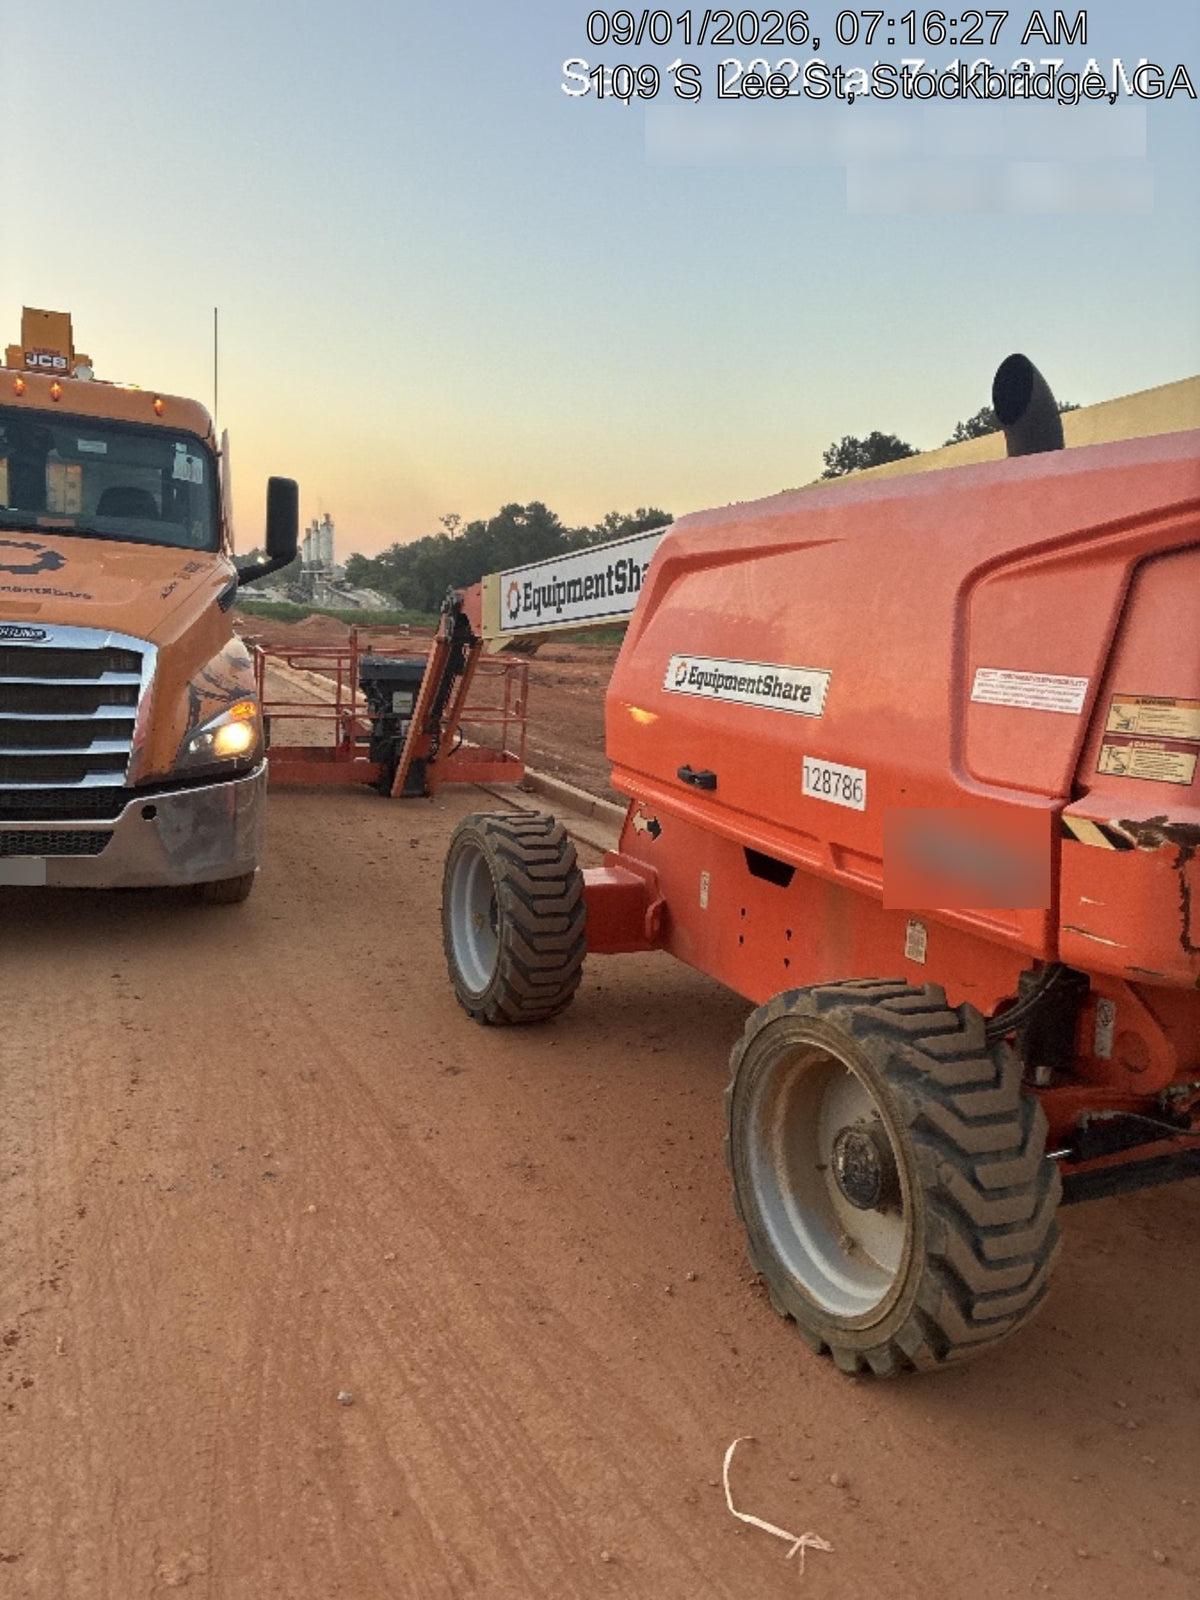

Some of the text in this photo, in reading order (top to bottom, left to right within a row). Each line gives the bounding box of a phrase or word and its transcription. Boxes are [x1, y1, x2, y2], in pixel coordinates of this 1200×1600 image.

[25, 353, 67, 370] JCB
[687, 665, 813, 703] EquipmentShare
[803, 765, 864, 804] 128786
